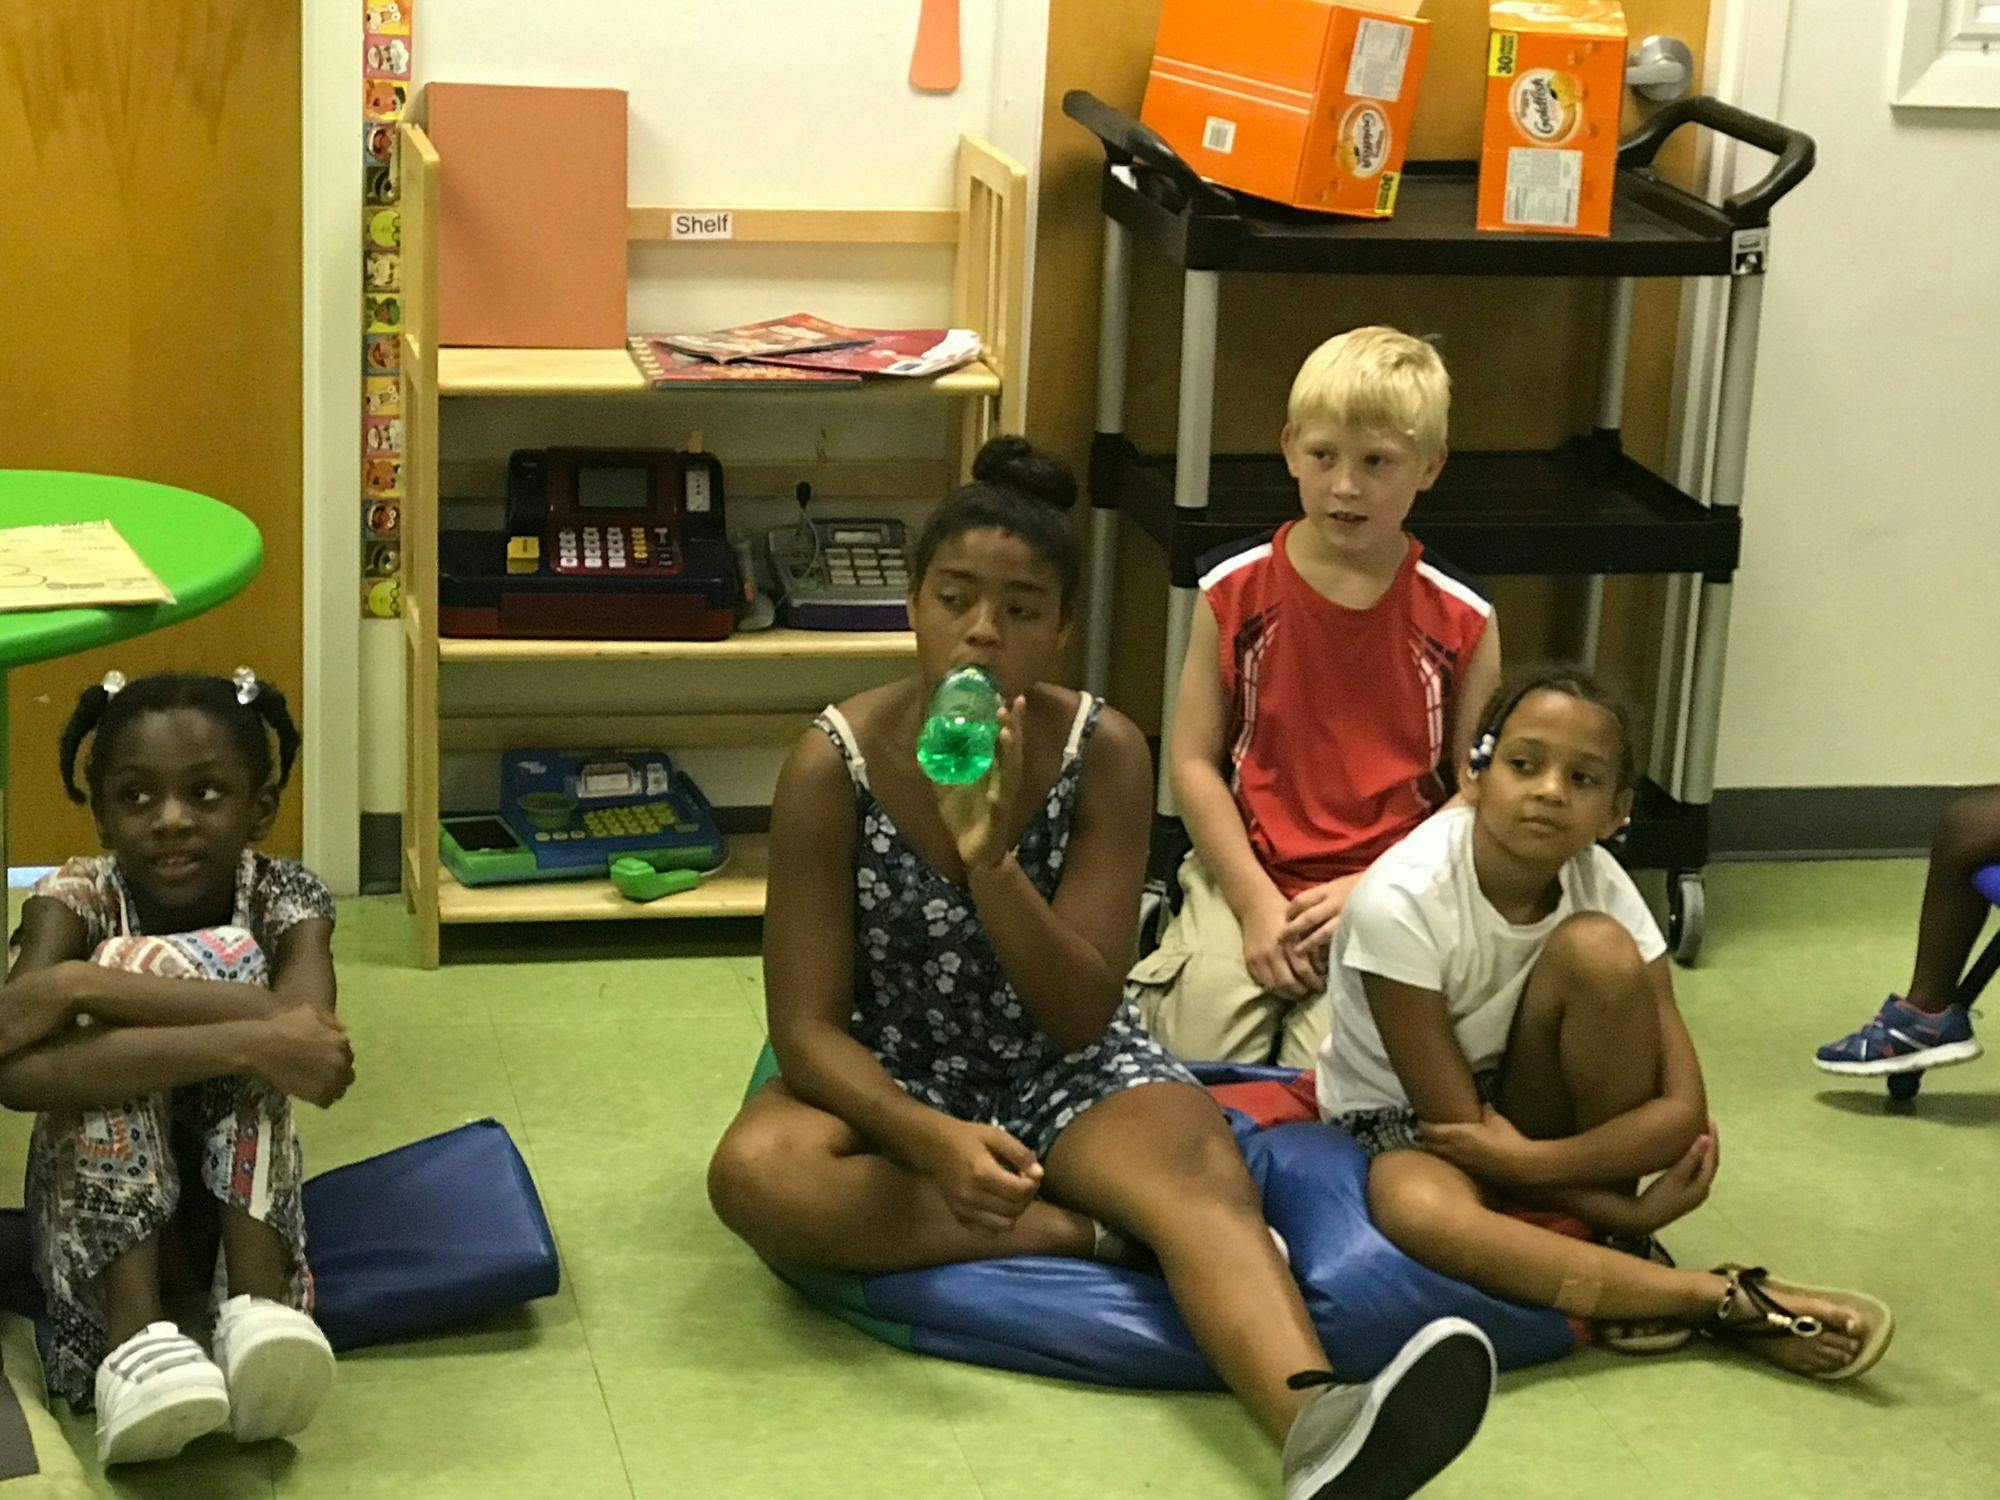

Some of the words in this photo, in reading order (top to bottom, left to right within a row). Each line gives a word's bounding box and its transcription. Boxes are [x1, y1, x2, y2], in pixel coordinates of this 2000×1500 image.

[1497, 55, 1513, 74] 30
[1531, 77, 1554, 134] Goldfish
[1361, 112, 1376, 168] Goldfish
[1382, 174, 1394, 191] 30
[675, 213, 729, 235] Shelf
